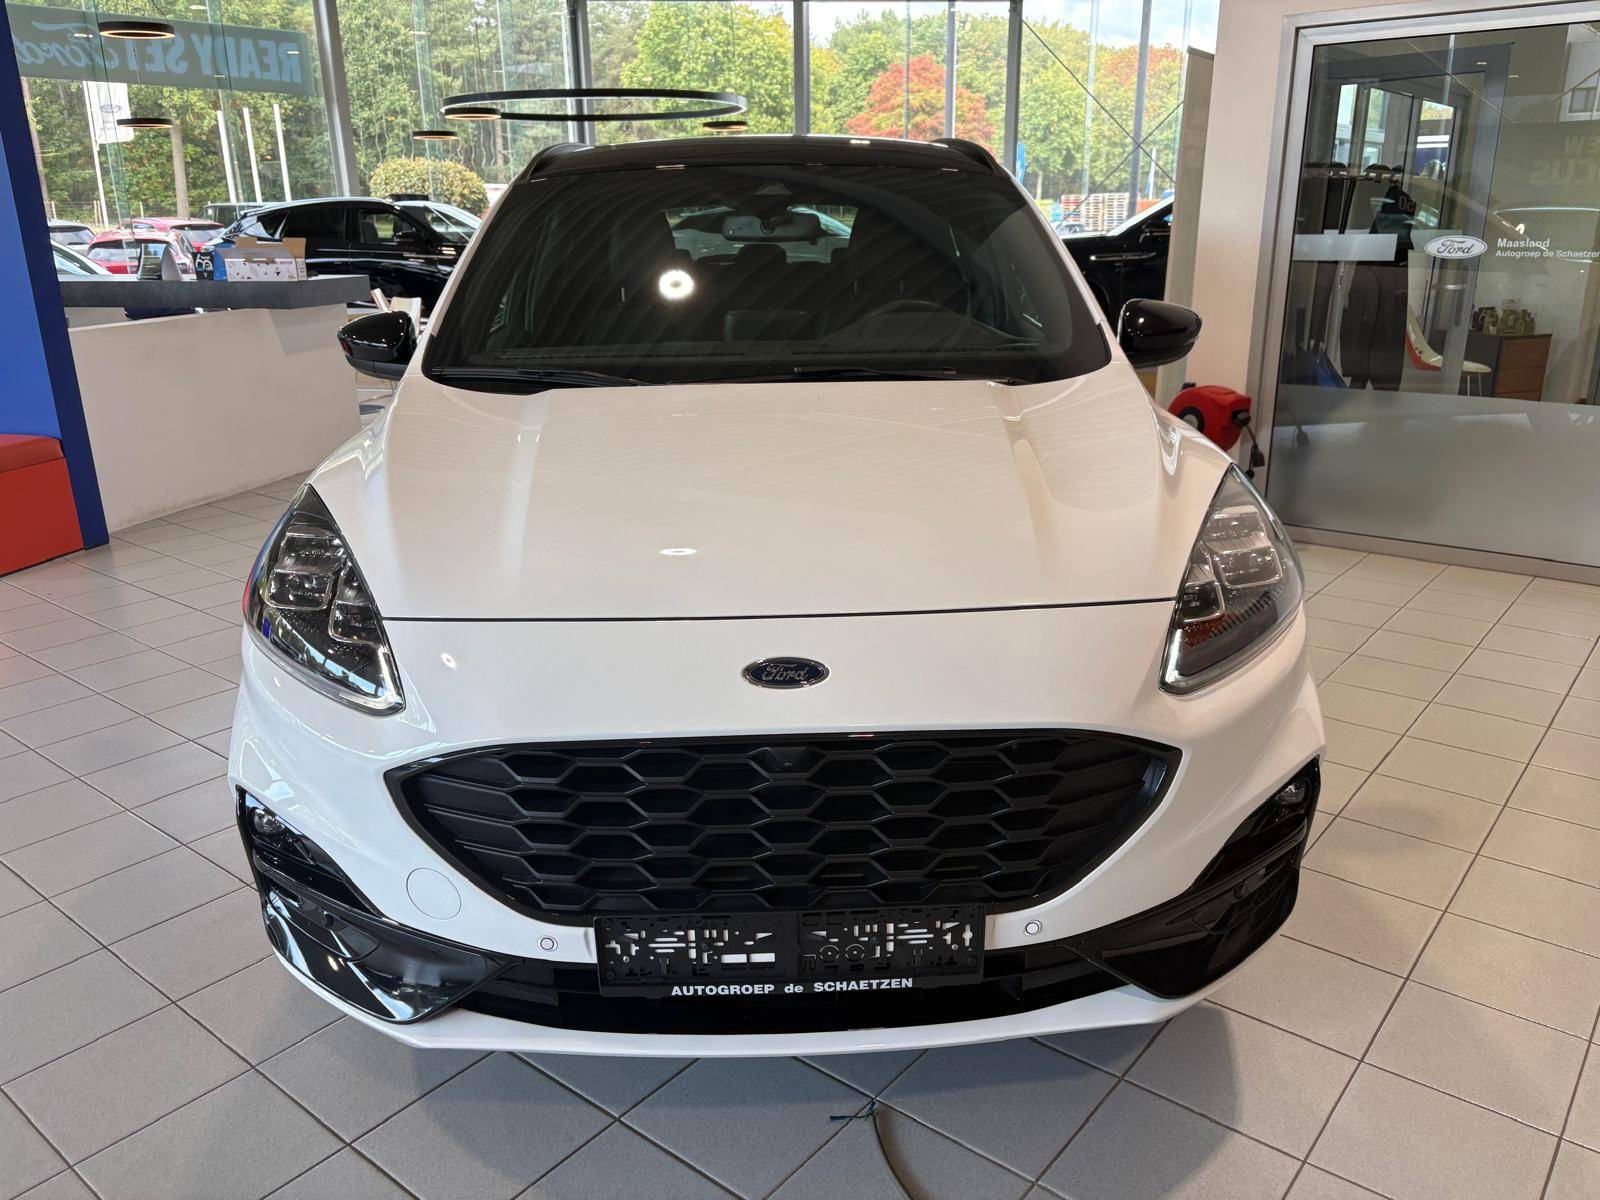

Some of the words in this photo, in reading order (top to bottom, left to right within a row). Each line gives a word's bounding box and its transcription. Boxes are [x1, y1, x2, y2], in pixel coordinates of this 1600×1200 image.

[1497, 238, 1550, 248] Maasland
[1495, 250, 1541, 259] Autogroep
[1543, 249, 1554, 257] de
[671, 984, 775, 996] AUTOGROEP
[784, 983, 804, 993] de
[813, 977, 913, 993] SCHAETZEN
